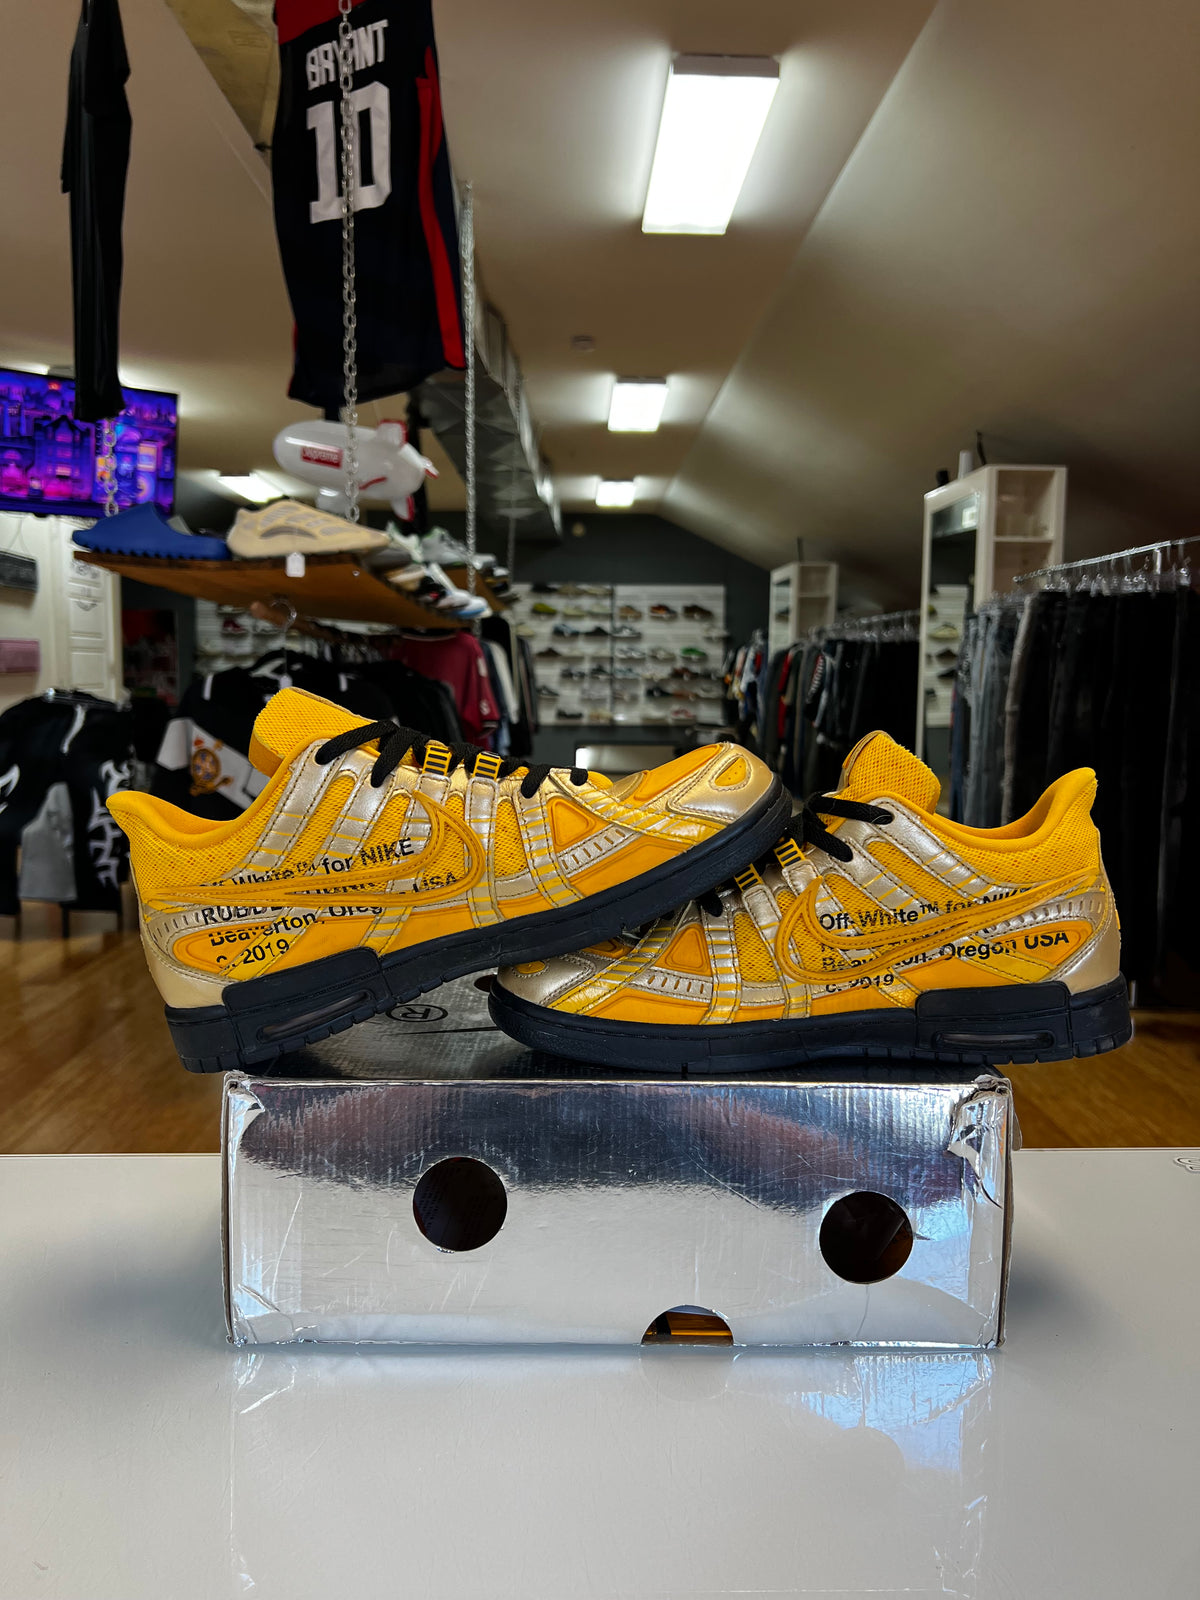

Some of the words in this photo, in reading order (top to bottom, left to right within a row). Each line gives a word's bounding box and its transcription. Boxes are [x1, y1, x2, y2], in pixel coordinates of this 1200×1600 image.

[306, 19, 389, 90] BRYANT
[306, 81, 392, 224] 10
[322, 856, 352, 874] for
[360, 837, 414, 866] NIKE
[329, 906, 383, 918] Oreg
[241, 938, 290, 965] 2019
[940, 939, 1017, 960] Oregon
[1024, 932, 1069, 949] USA
